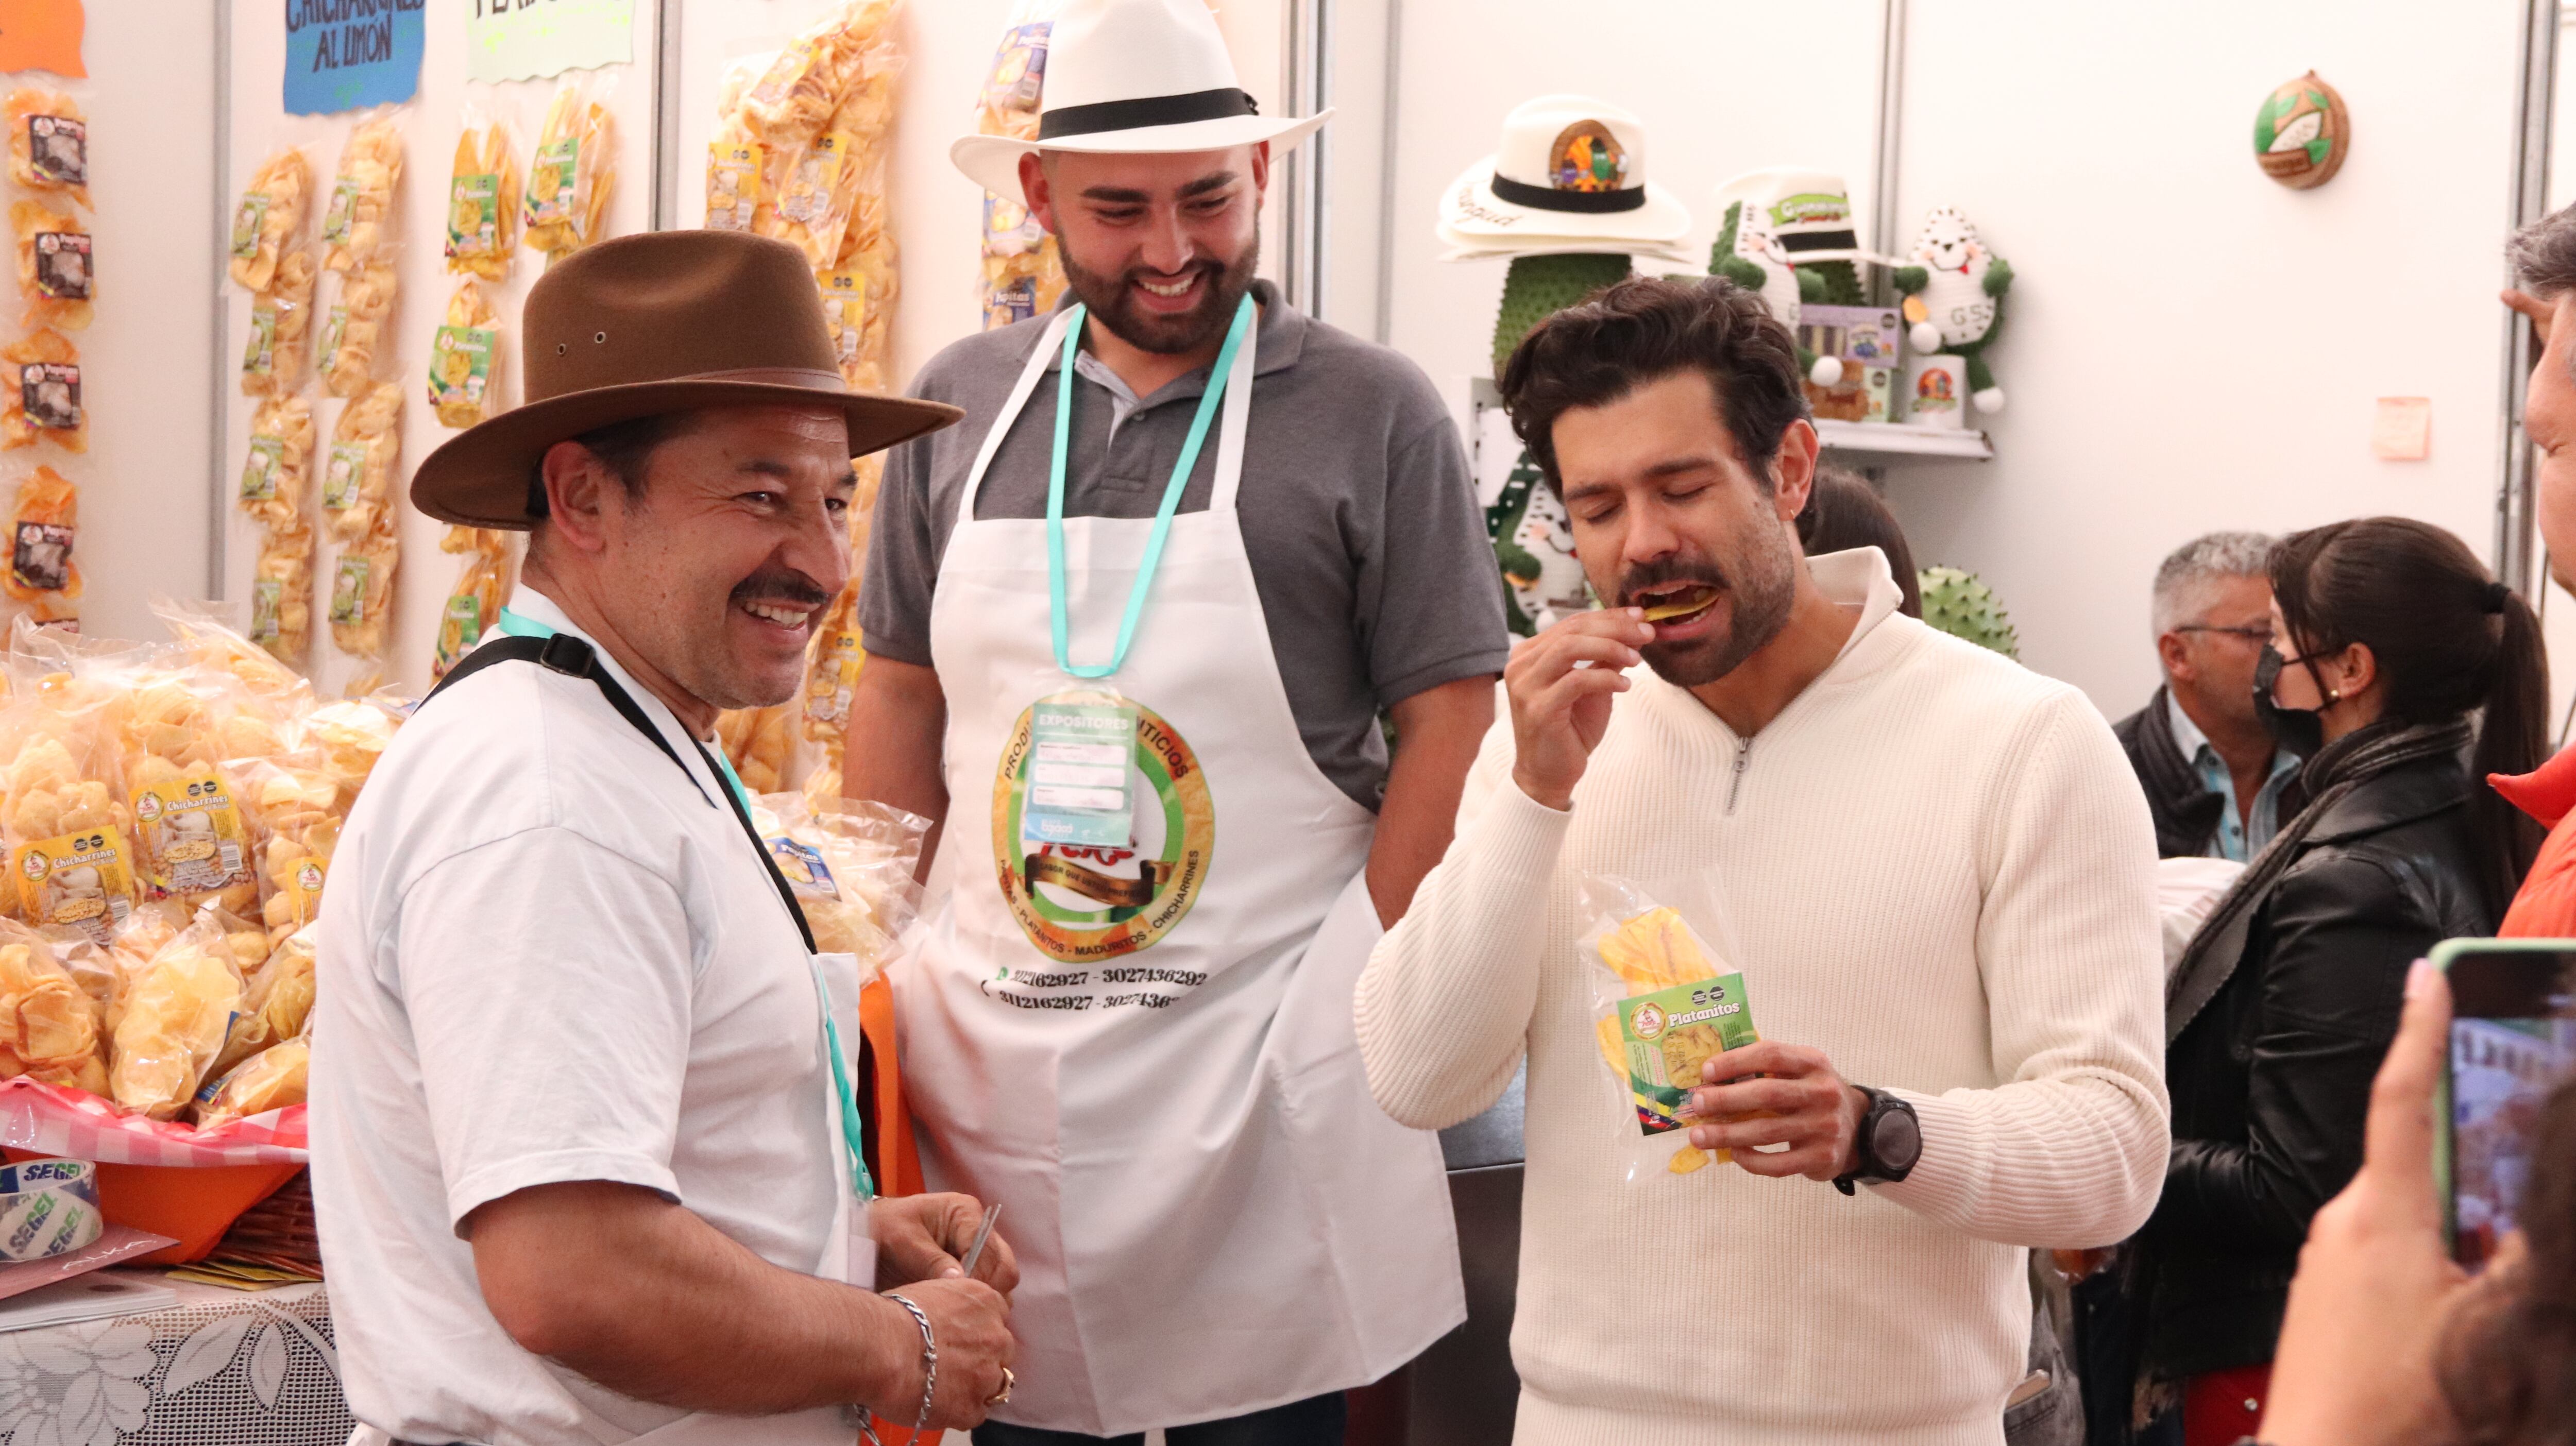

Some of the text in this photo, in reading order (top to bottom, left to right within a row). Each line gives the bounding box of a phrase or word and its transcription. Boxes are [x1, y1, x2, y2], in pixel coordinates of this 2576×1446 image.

[313, 29, 338, 72] AL
[1039, 714, 1128, 730] EXPOSITORES
[166, 795, 229, 811] Chicharrines
[53, 848, 116, 869] Chicharrines
[1075, 931, 1147, 955] MADURITOS
[1153, 850, 1199, 929] CHICHARRINES
[1103, 968, 1208, 986] 3027436292
[999, 990, 1094, 1010] 3112162927
[1103, 992, 1180, 1009] 3027436
[1668, 1002, 1740, 1028] Platanitos
